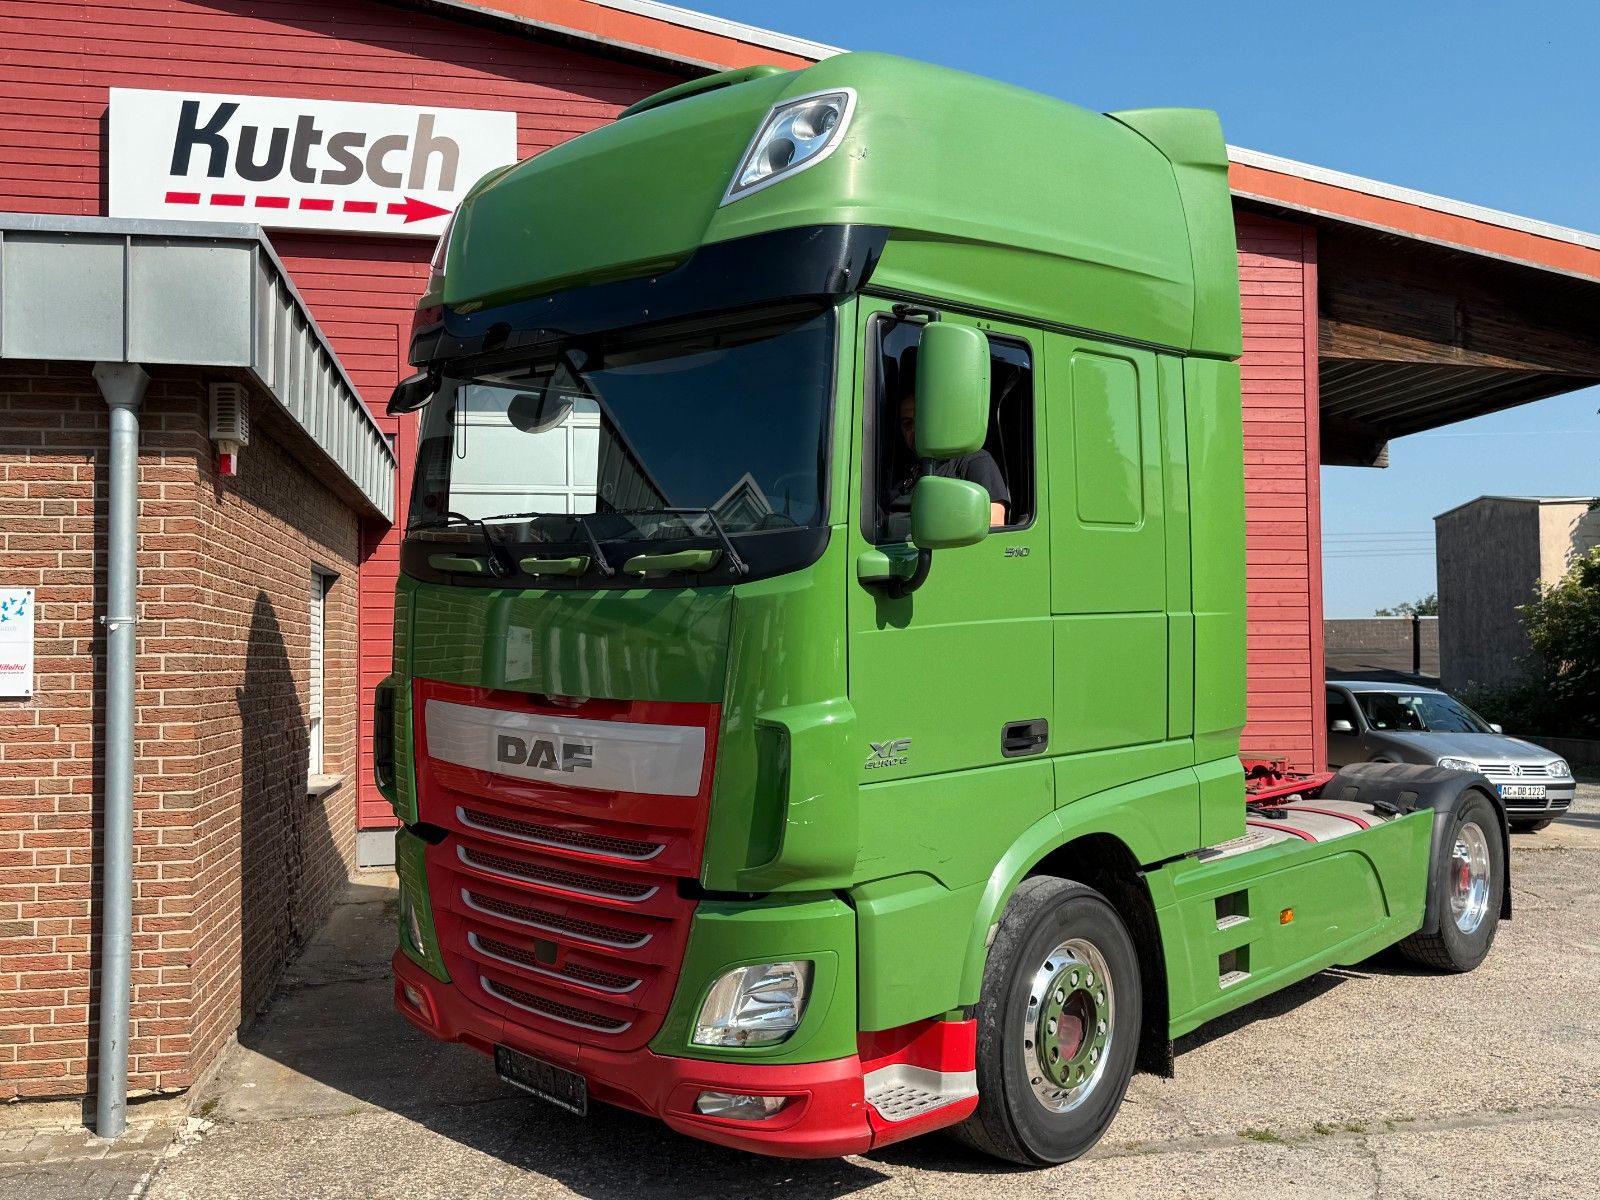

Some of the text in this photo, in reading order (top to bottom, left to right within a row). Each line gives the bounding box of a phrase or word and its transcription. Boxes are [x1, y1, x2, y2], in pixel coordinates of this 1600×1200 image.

[169, 99, 460, 192] Kutsch
[1003, 546, 1031, 558] 510
[497, 734, 593, 773] DAF
[866, 737, 912, 761] XF
[1502, 786, 1513, 796] AC
[1528, 786, 1545, 796] 1223
